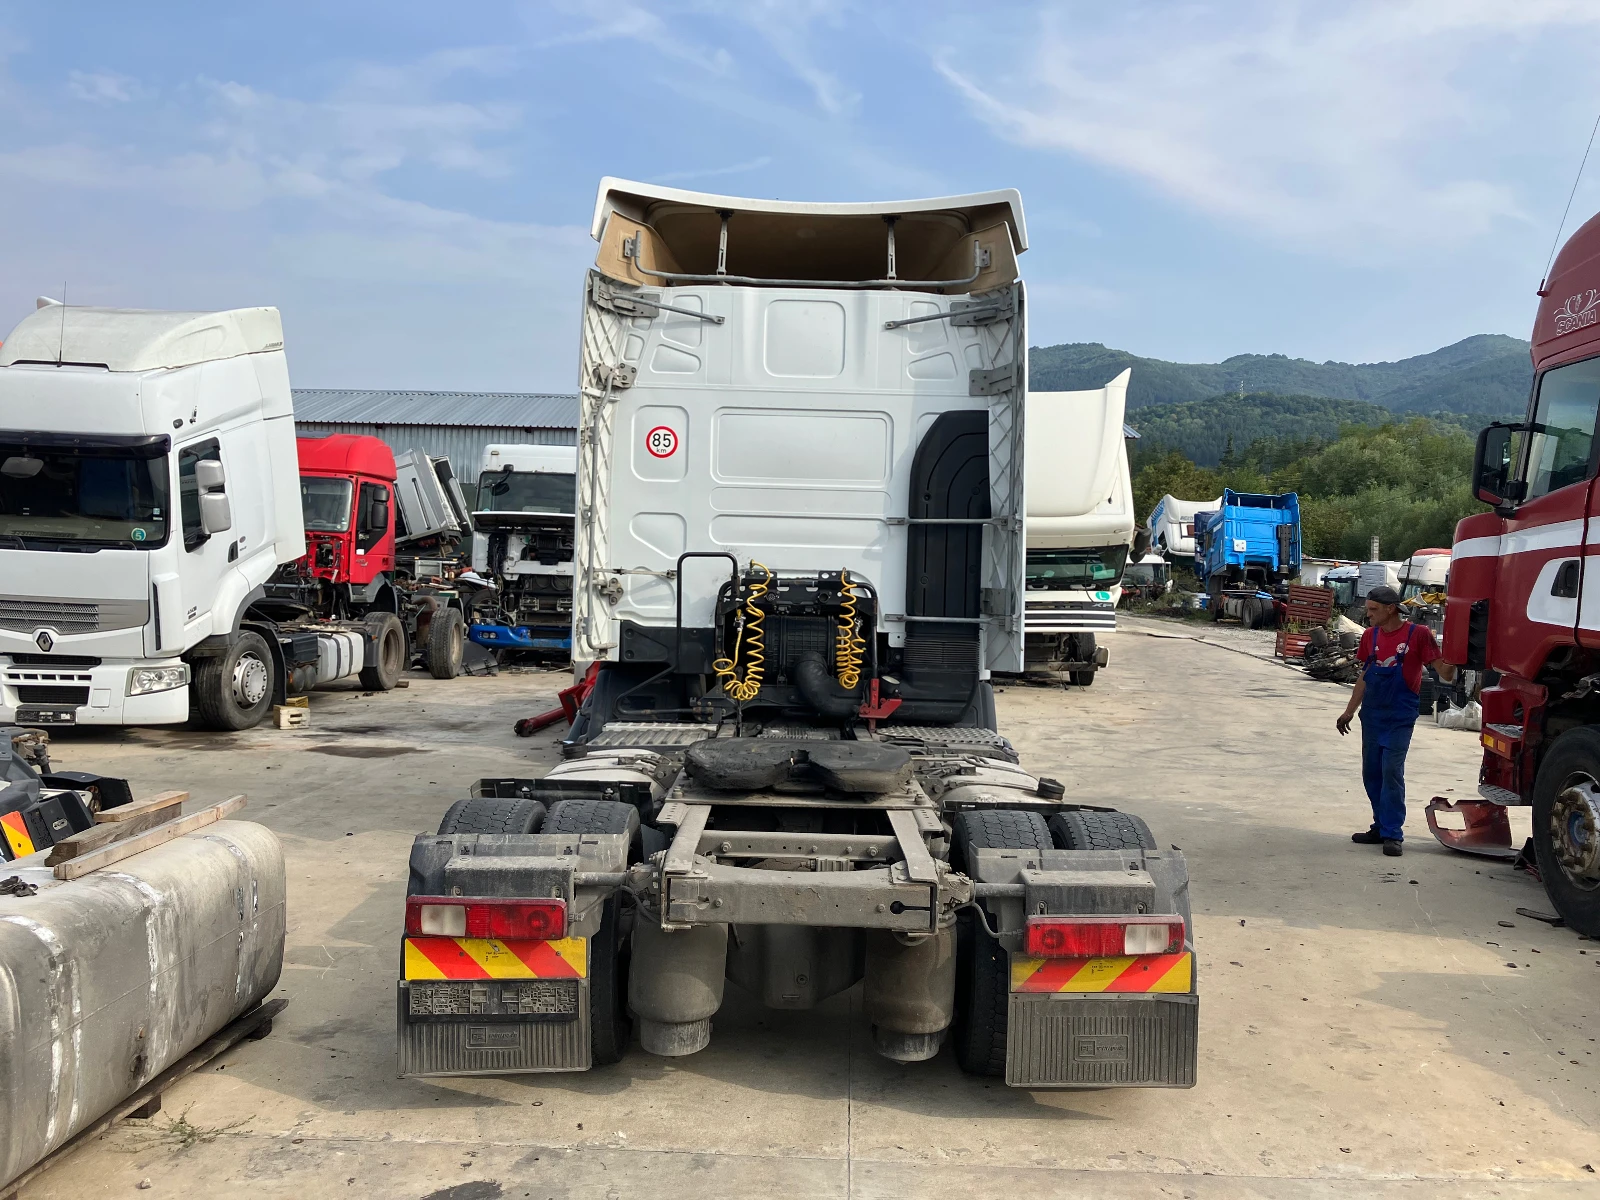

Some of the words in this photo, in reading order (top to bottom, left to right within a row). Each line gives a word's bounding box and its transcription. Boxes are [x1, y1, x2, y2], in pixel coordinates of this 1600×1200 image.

[1556, 309, 1597, 336] SCANIA
[652, 433, 671, 448] 85
[135, 530, 142, 541] 5
